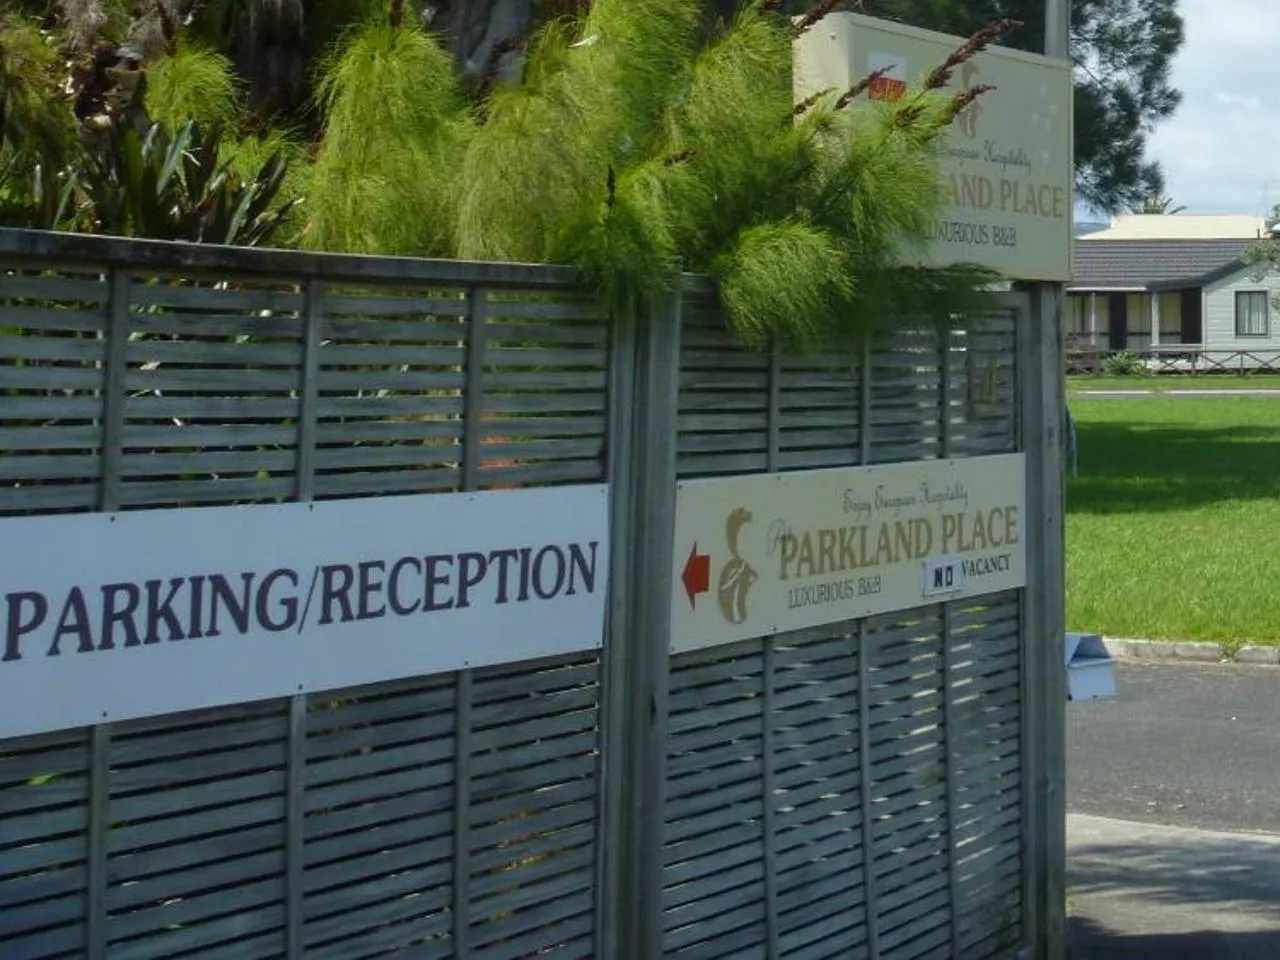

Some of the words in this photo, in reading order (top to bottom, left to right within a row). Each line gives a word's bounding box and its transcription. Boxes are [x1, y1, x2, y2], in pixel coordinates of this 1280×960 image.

[1000, 178, 1064, 218] PLACE
[779, 518, 933, 580] PARKLAND
[941, 506, 1018, 554] PLACE
[934, 567, 954, 588] NO
[961, 554, 1011, 577] VACANCY
[1, 542, 599, 662] PARKING/RECEPTION
